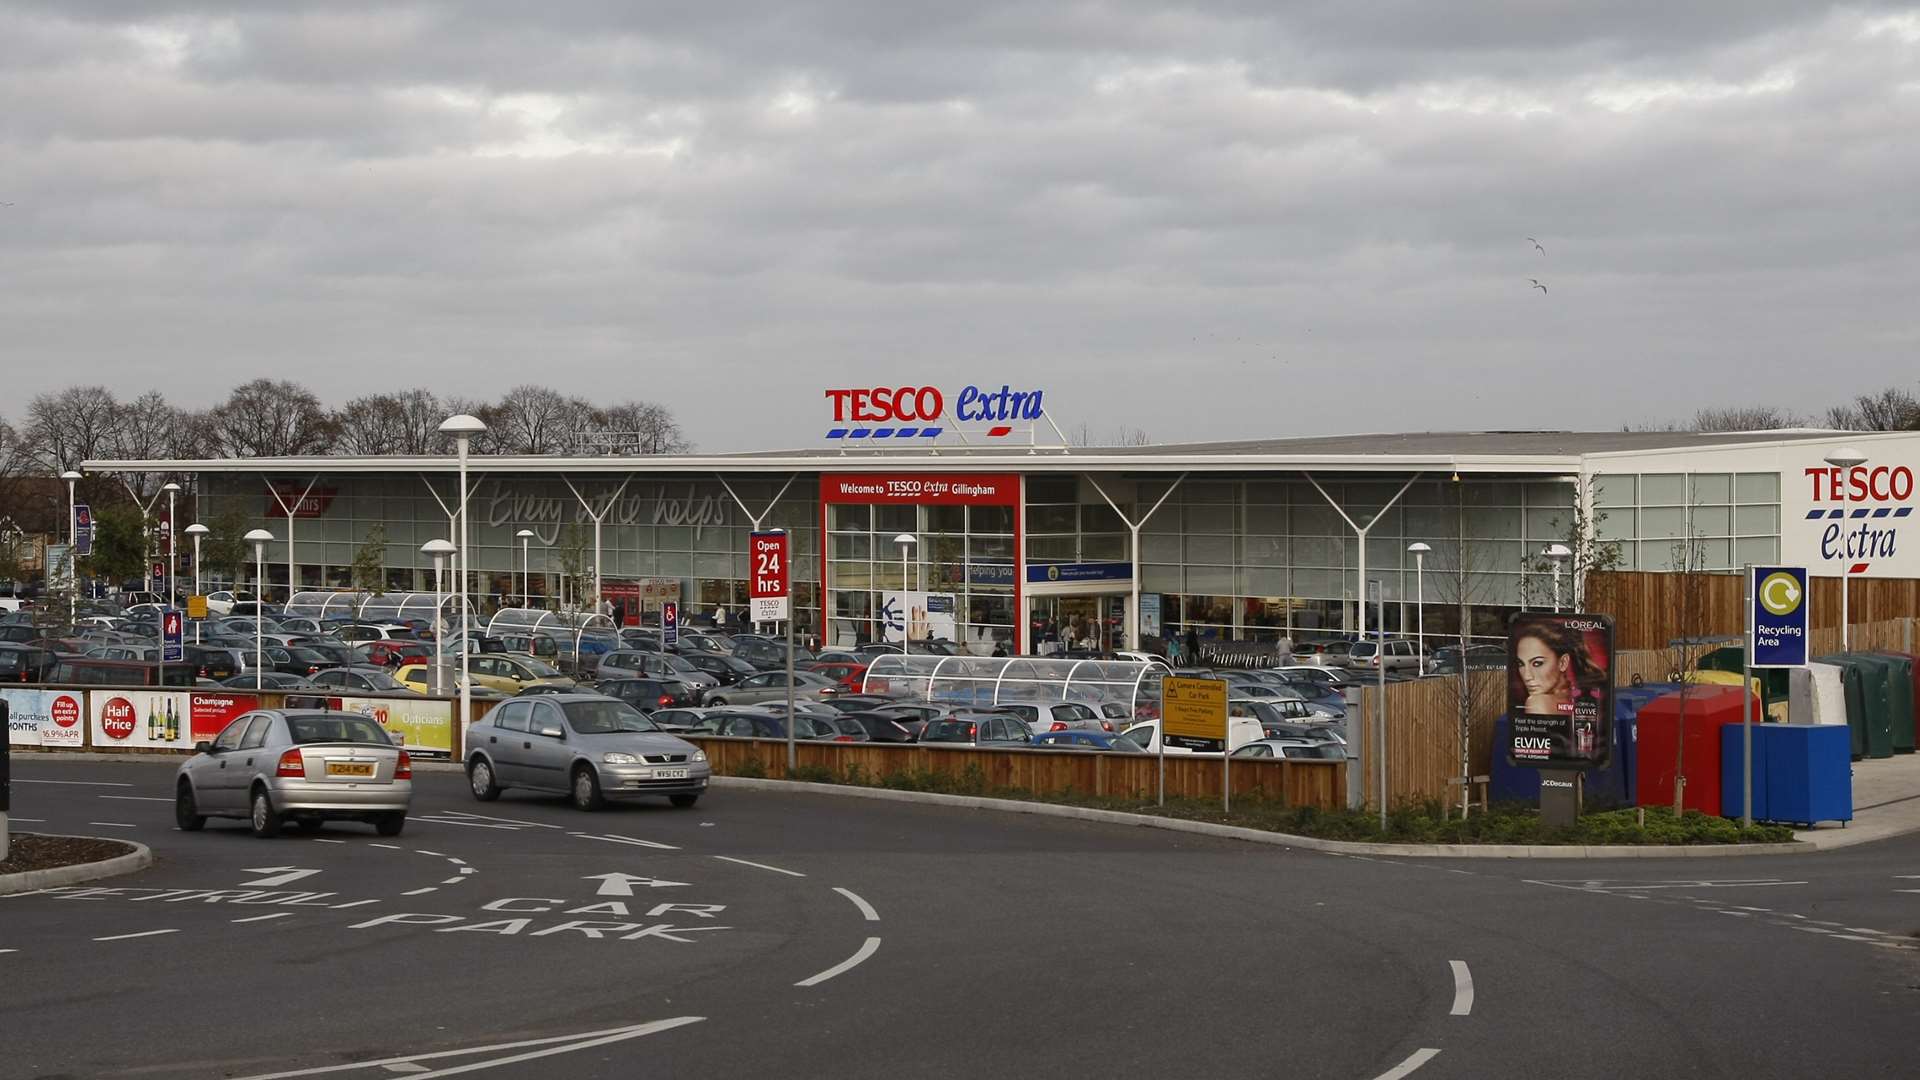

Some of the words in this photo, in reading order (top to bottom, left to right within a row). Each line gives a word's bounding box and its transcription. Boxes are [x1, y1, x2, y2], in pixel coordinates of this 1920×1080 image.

[825, 386, 944, 422] TESCO
[956, 385, 1044, 422] extra
[840, 483, 875, 494] Welcome
[876, 484, 884, 494] to
[887, 481, 921, 492] TESCO
[924, 481, 949, 493] extra
[952, 484, 995, 497] Gillingham
[1804, 466, 1914, 502] TESCO
[488, 484, 562, 546] Every
[652, 484, 729, 541] helps
[757, 540, 780, 552] Open
[1821, 523, 1896, 560] extra
[757, 553, 780, 575] 24
[757, 576, 780, 592] hrs
[1758, 624, 1802, 637] Recycling
[1758, 637, 1780, 646] Area
[194, 696, 234, 708] Champagne
[107, 706, 130, 717] Half
[402, 712, 444, 726] Opticians
[105, 718, 132, 730] Price
[1514, 736, 1550, 750] ELVIVE
[1542, 780, 1572, 788] JCDecaux
[481, 898, 727, 918] CAR
[347, 913, 734, 942] PARK
